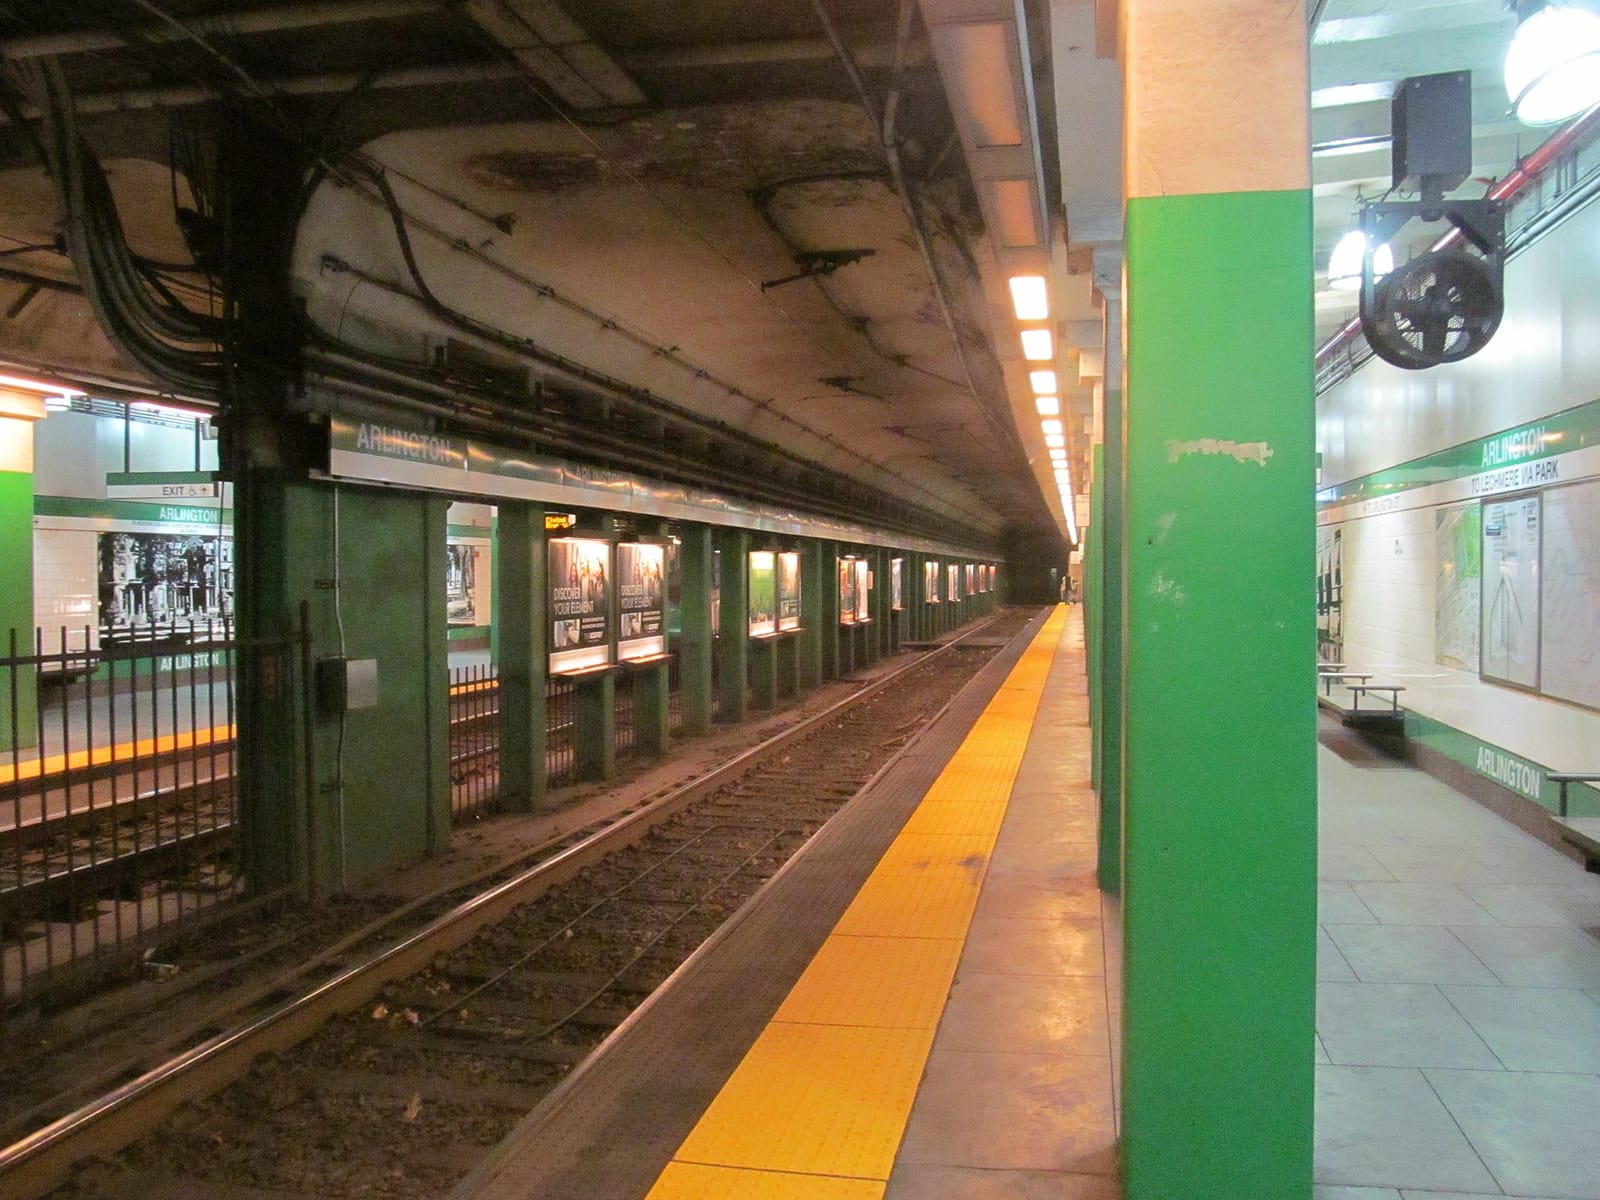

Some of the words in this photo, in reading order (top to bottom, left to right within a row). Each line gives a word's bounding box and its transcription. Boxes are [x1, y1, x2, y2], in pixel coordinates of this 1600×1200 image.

[357, 422, 451, 462] ARLINGTON
[1481, 425, 1546, 468] ARLINGTON
[1471, 477, 1480, 495] TO
[1481, 468, 1519, 493] LECHMERE
[1521, 465, 1533, 485] VIA
[1535, 458, 1559, 481] PARK
[162, 486, 184, 496] EXIT
[160, 507, 218, 523] ARLINGTON
[554, 587, 581, 600] DISCOVER
[554, 602, 570, 616] YOUR
[571, 600, 594, 614] ELEMENT
[1476, 745, 1541, 798] ARLINGTON
